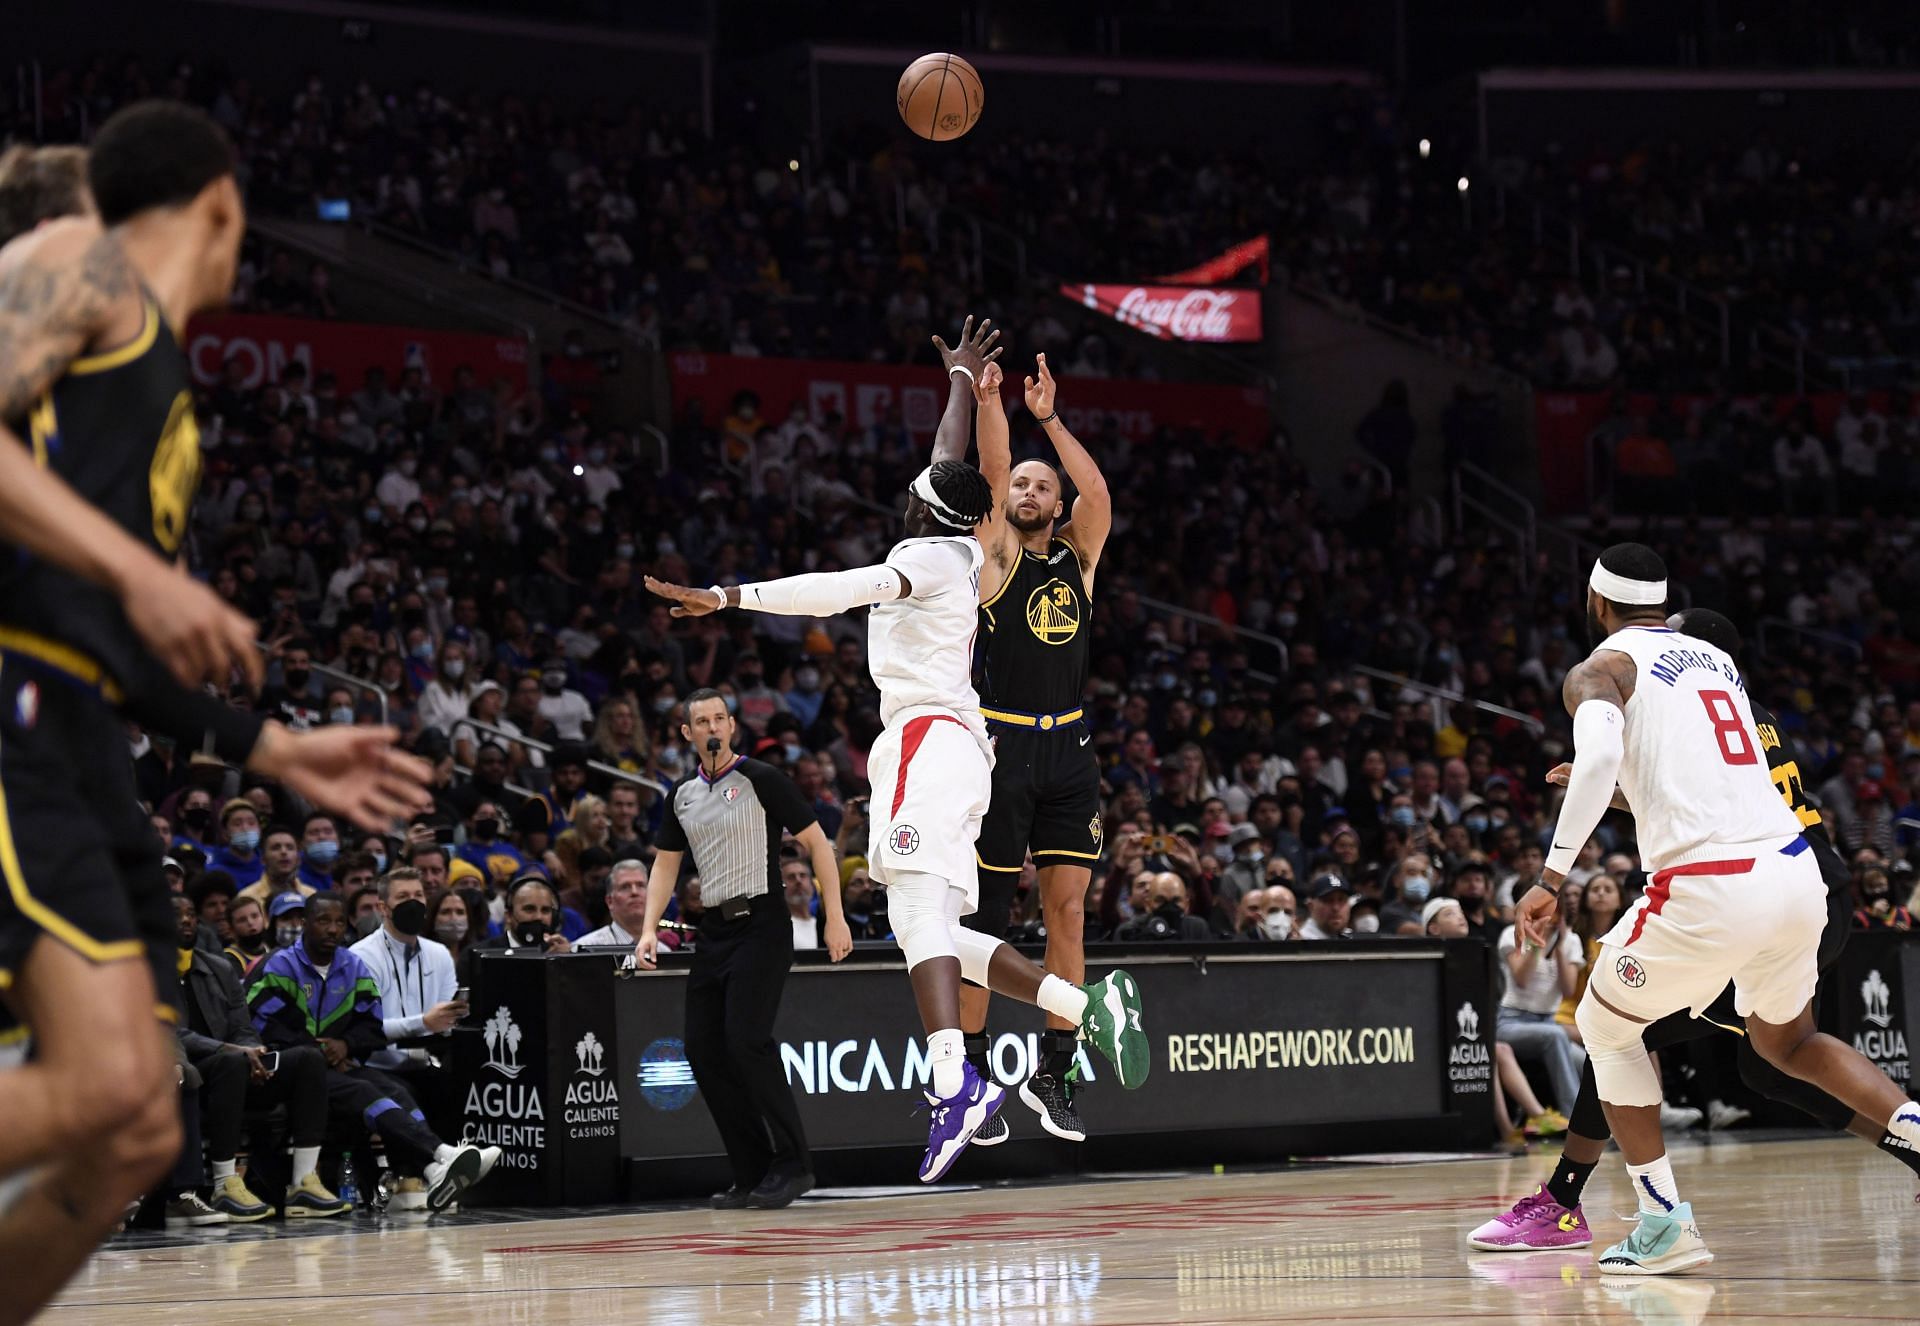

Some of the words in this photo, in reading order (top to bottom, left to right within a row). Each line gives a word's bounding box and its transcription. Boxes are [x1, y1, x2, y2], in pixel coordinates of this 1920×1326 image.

[1053, 586, 1071, 606] 30
[1650, 649, 1718, 688] MORRIS
[1697, 689, 1759, 766] 8
[1168, 1026, 1415, 1072] RESHAPEWORK.COM
[1449, 1042, 1490, 1065] AGUA
[1853, 1029, 1909, 1060] AGUA
[1449, 1065, 1490, 1081] CALIENTE
[464, 1081, 545, 1121] AGUA
[565, 1080, 619, 1105] AGUA
[564, 1106, 620, 1124] CALIENTE
[462, 1121, 546, 1149] CALIENTE
[570, 1125, 616, 1140] CASINOS
